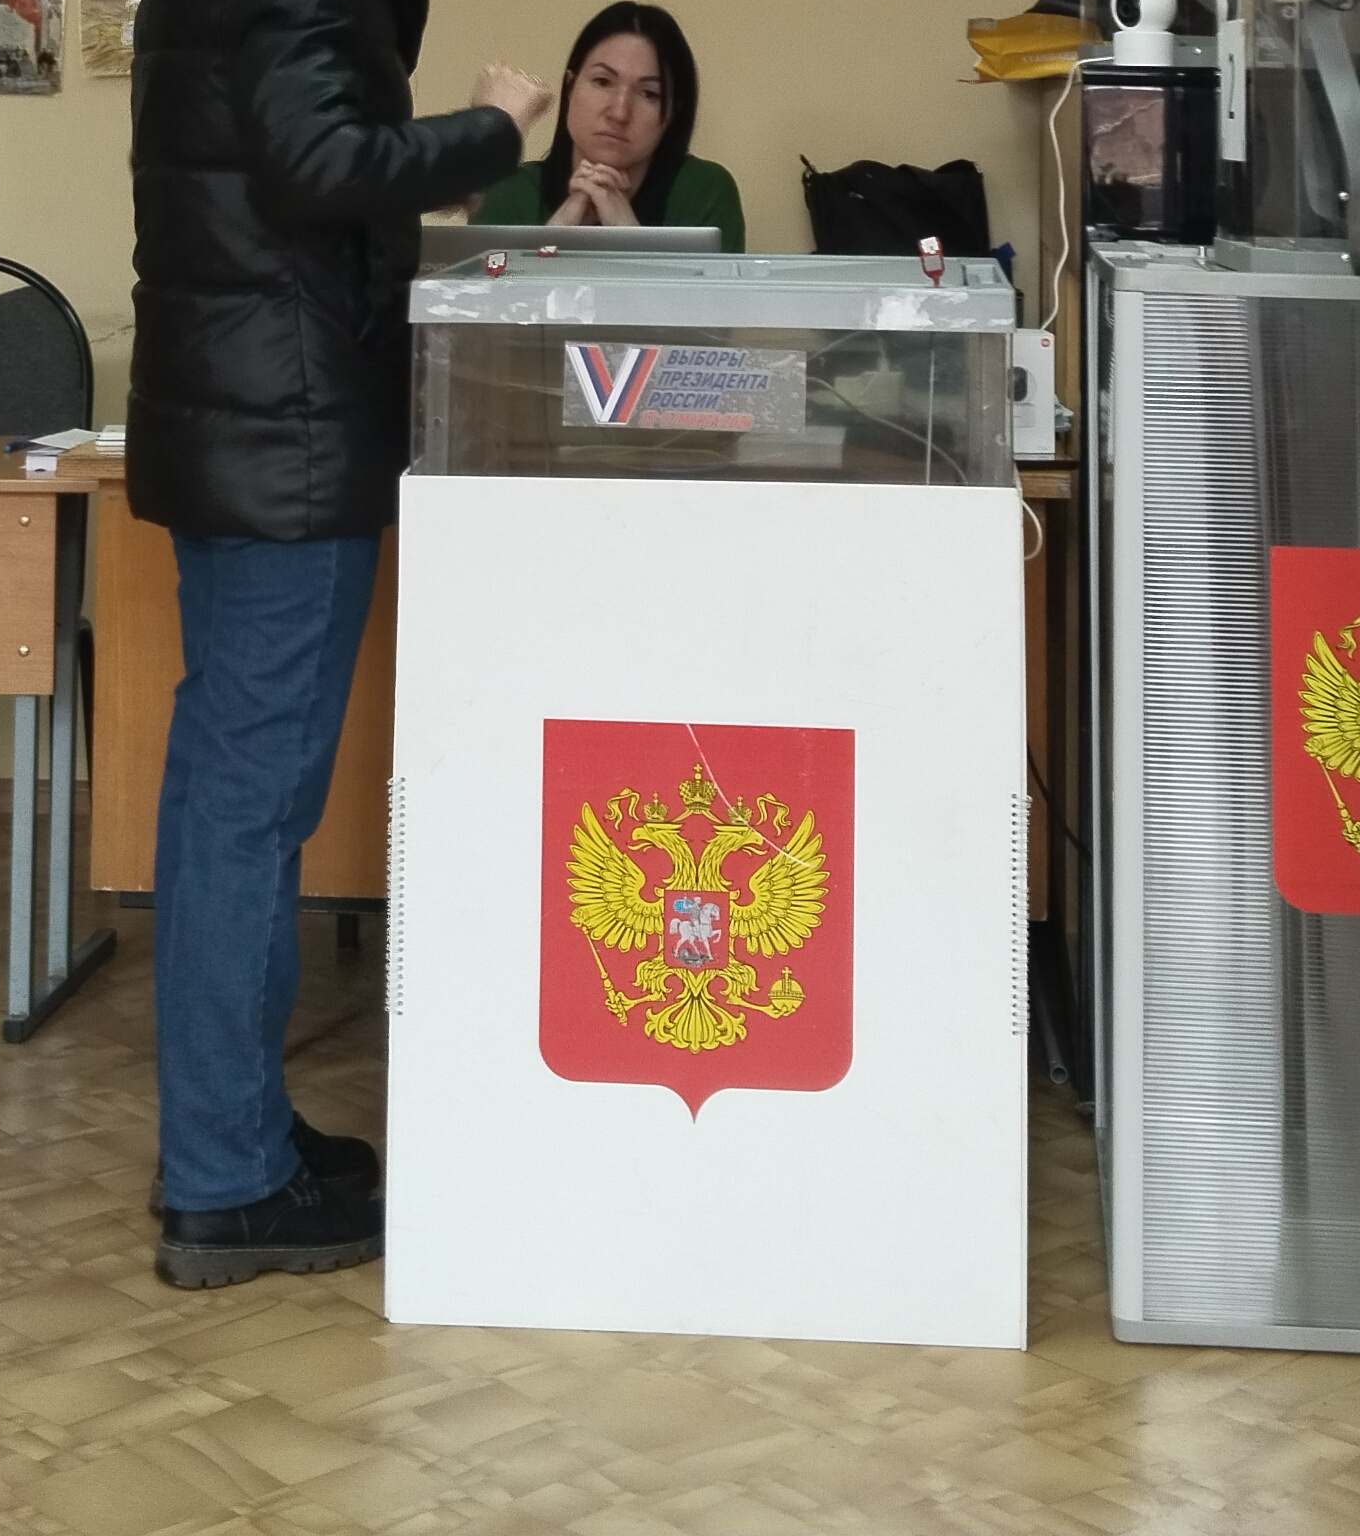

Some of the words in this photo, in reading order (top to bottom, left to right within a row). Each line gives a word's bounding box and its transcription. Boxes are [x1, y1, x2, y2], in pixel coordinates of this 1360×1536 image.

[668, 349, 747, 368] ВЫБОРЫ
[658, 370, 768, 390] ПРЕЗИДЕНТА
[648, 391, 721, 409] РОССИИ
